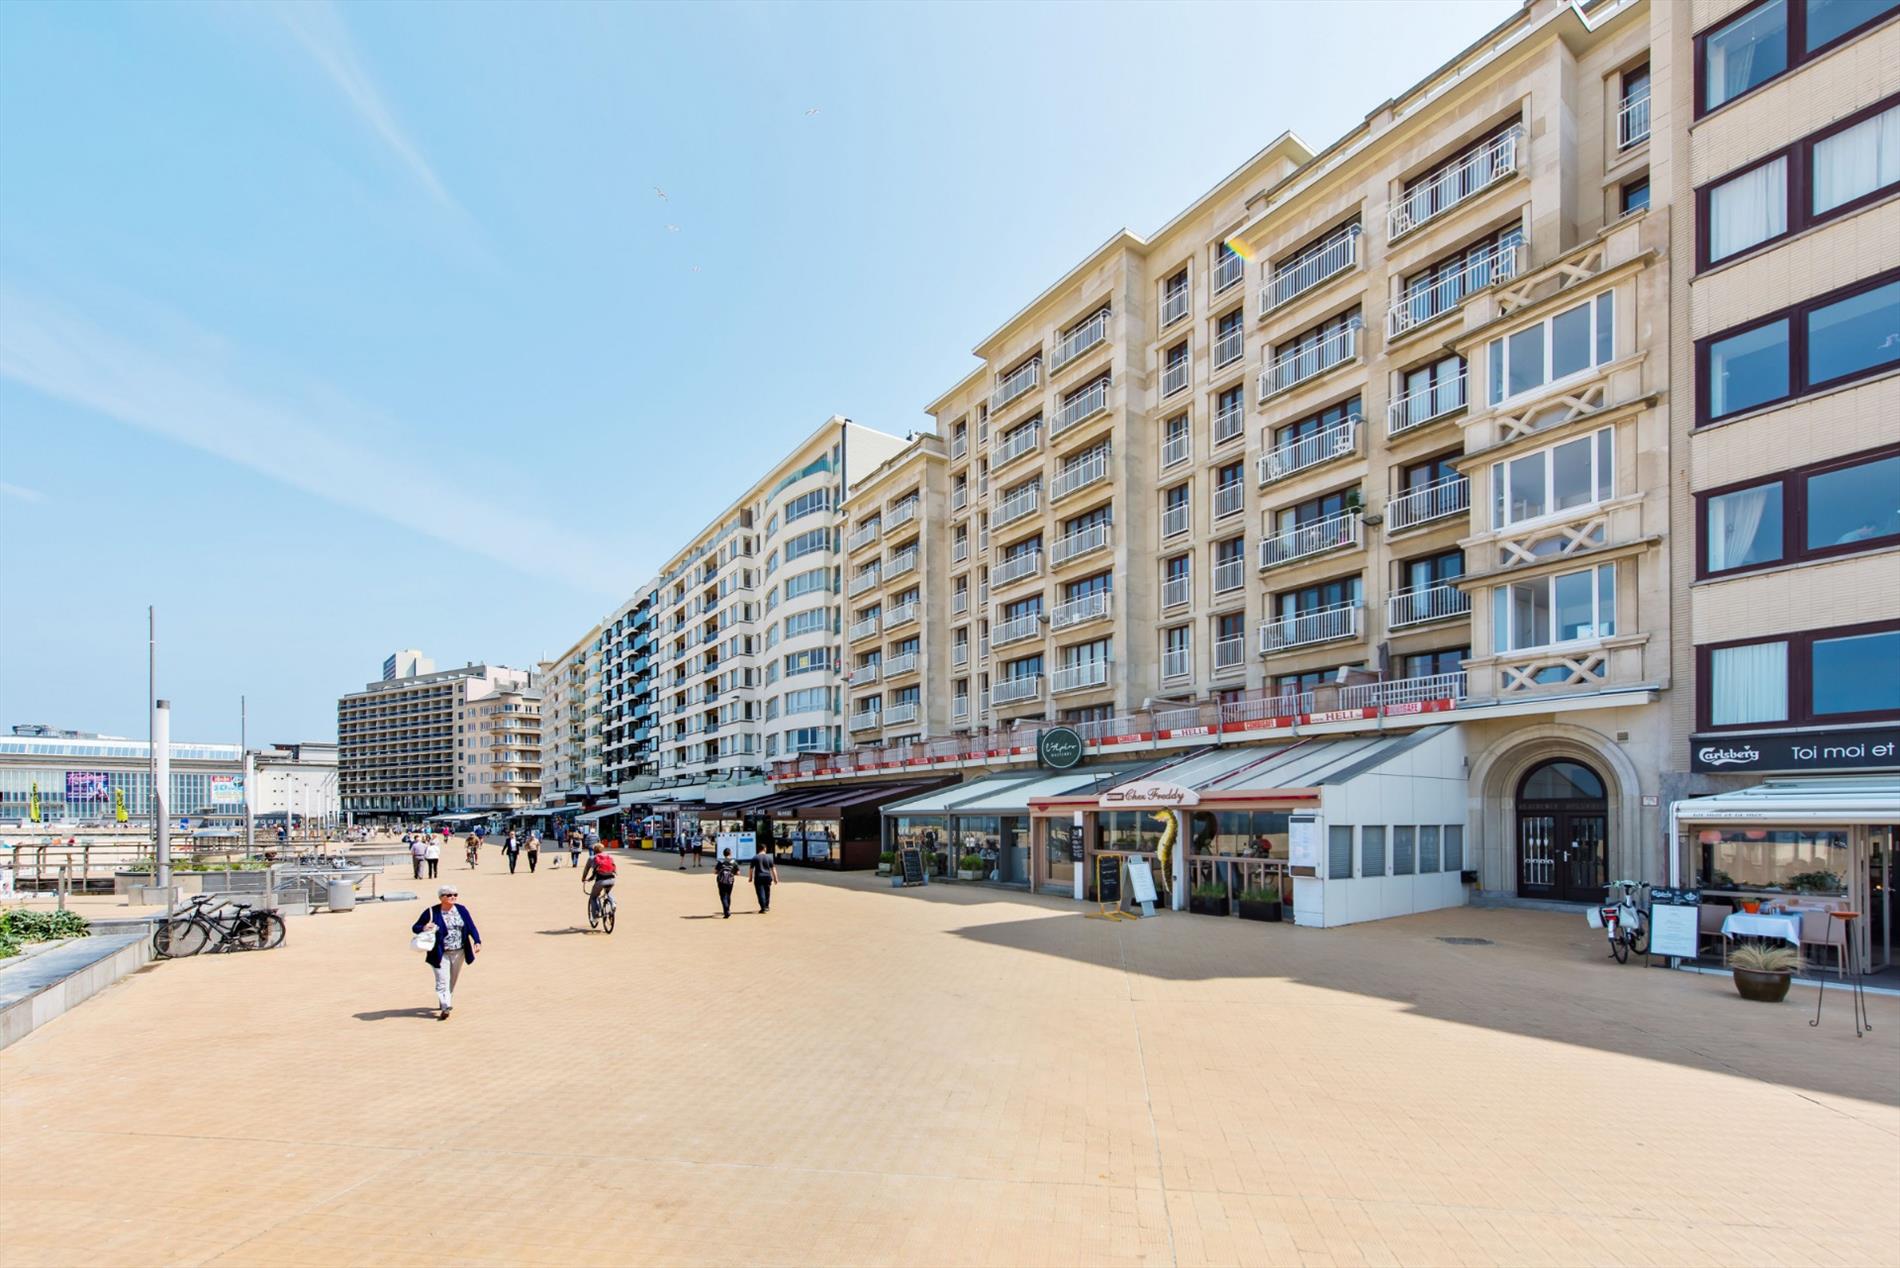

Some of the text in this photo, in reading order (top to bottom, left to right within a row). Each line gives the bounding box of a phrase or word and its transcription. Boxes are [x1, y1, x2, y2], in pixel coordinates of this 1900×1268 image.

[1699, 746, 1759, 766] Carlsberg
[1792, 742, 1896, 760] Toi moi et
[1147, 787, 1184, 804] Freddy
